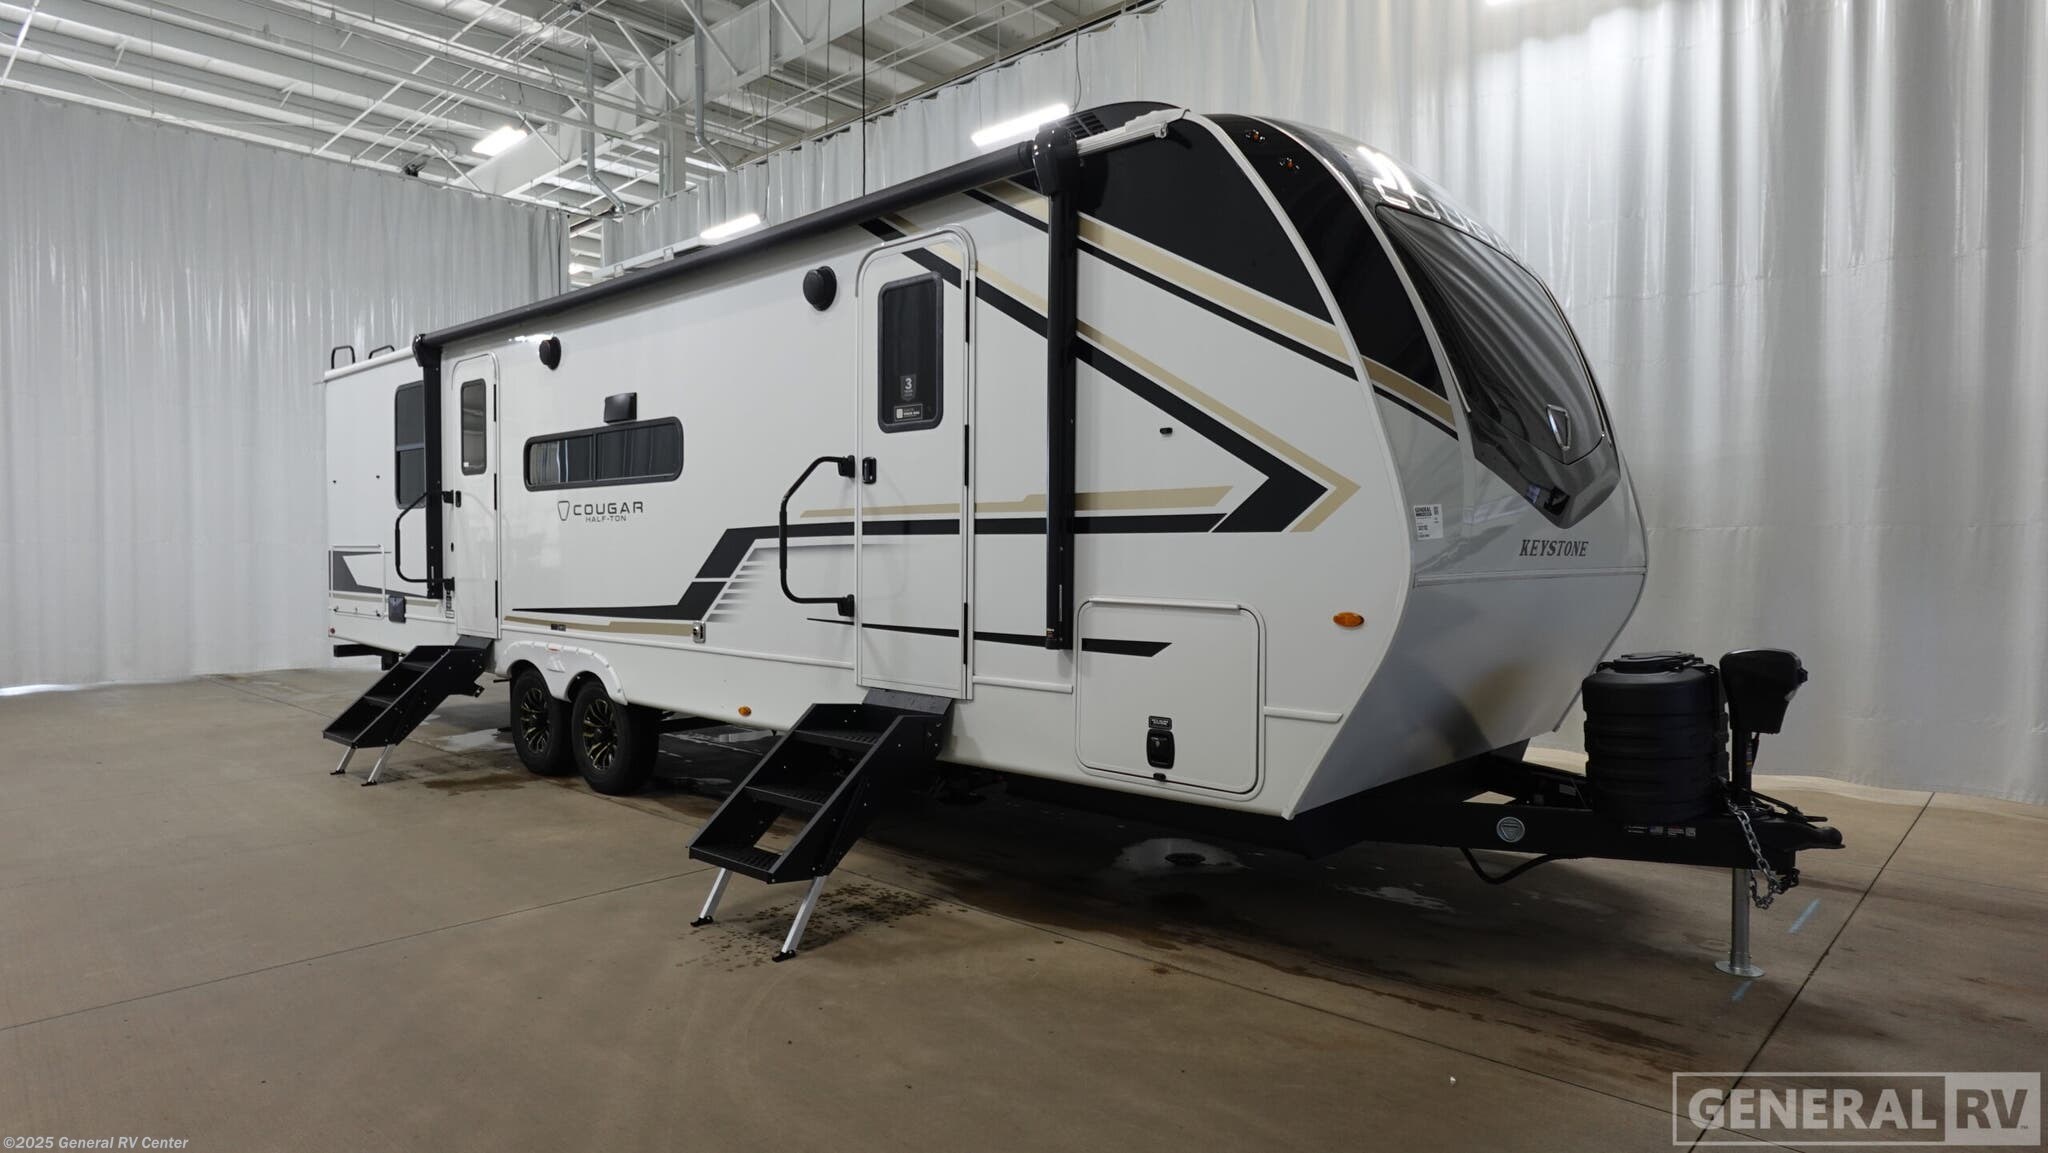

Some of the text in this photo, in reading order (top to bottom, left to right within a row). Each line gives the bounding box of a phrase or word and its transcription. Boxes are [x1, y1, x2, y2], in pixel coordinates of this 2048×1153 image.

[905, 377, 912, 390] 3
[573, 501, 643, 515] COUGAR
[1519, 539, 1589, 556] KEYSTONE
